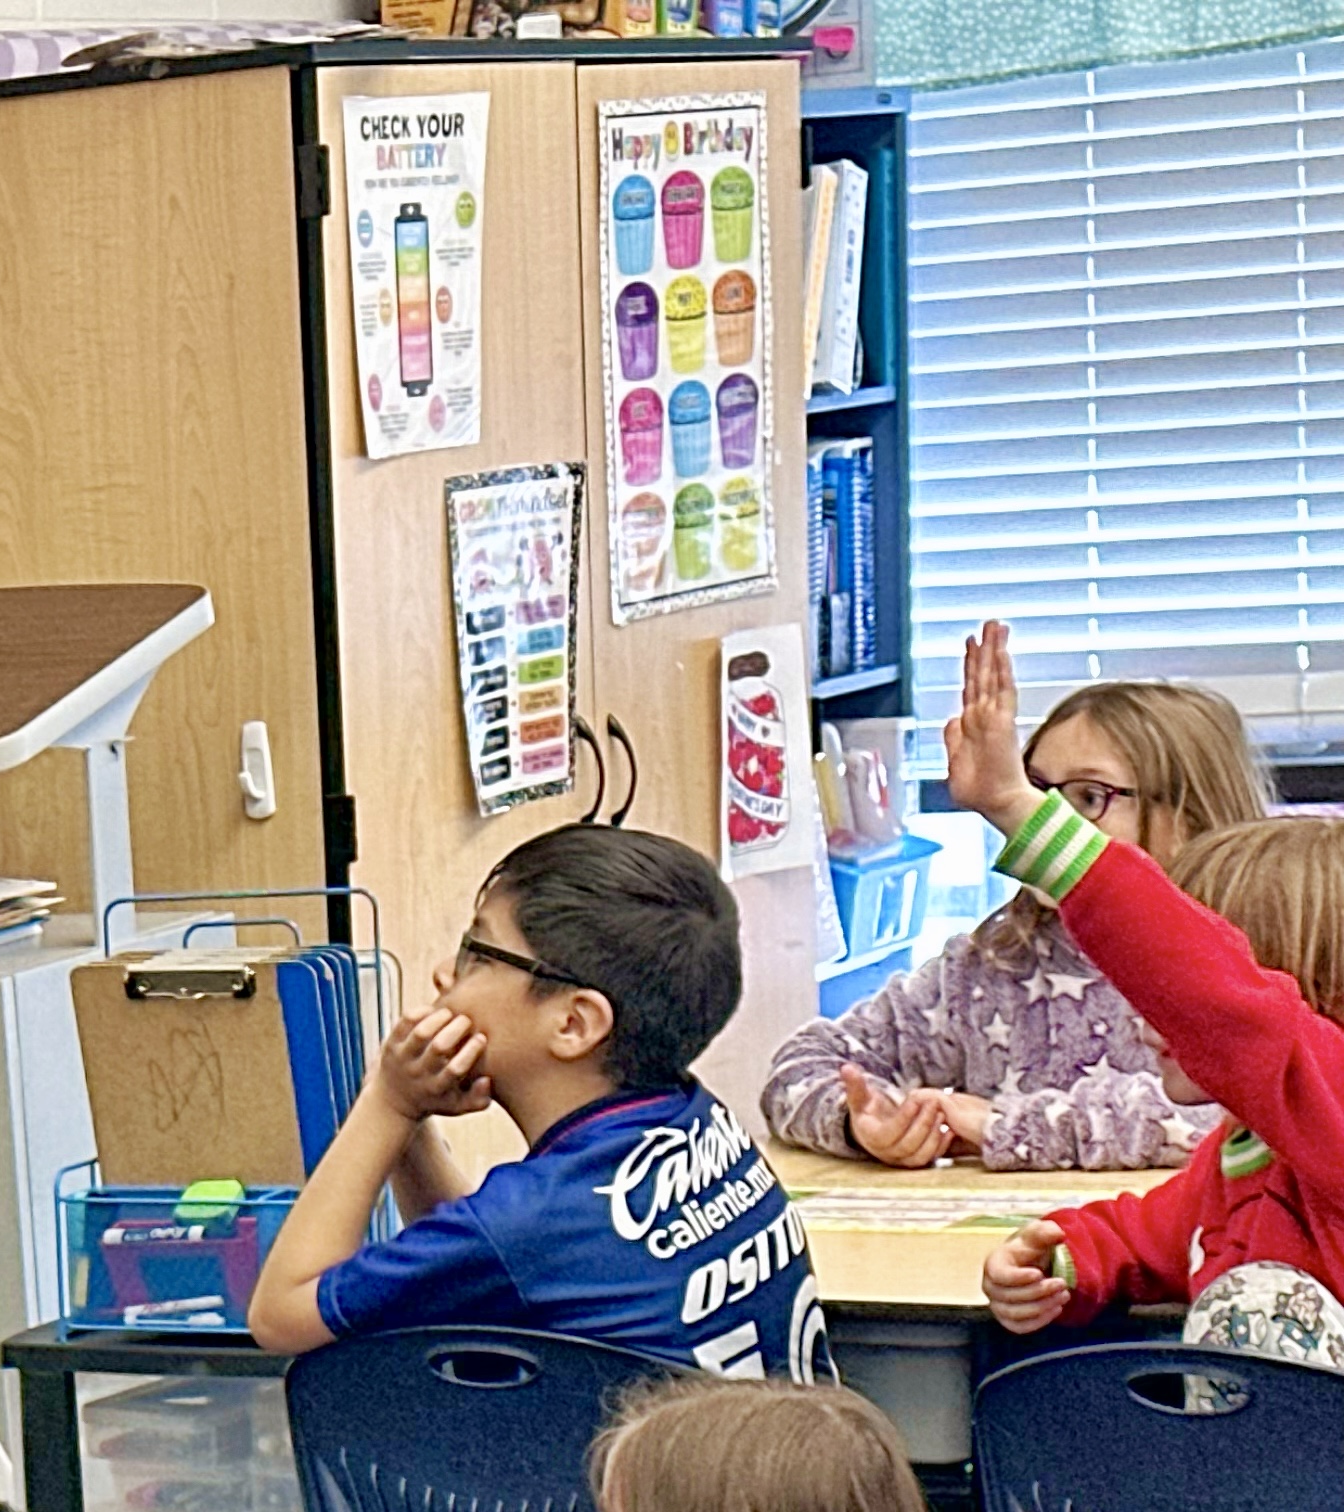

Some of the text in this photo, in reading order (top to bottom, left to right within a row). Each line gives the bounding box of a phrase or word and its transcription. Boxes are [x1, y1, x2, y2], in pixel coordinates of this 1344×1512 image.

[361, 112, 465, 141] CHECK YOUR
[376, 142, 447, 171] BATTERY
[647, 1157, 777, 1260] caliente.m
